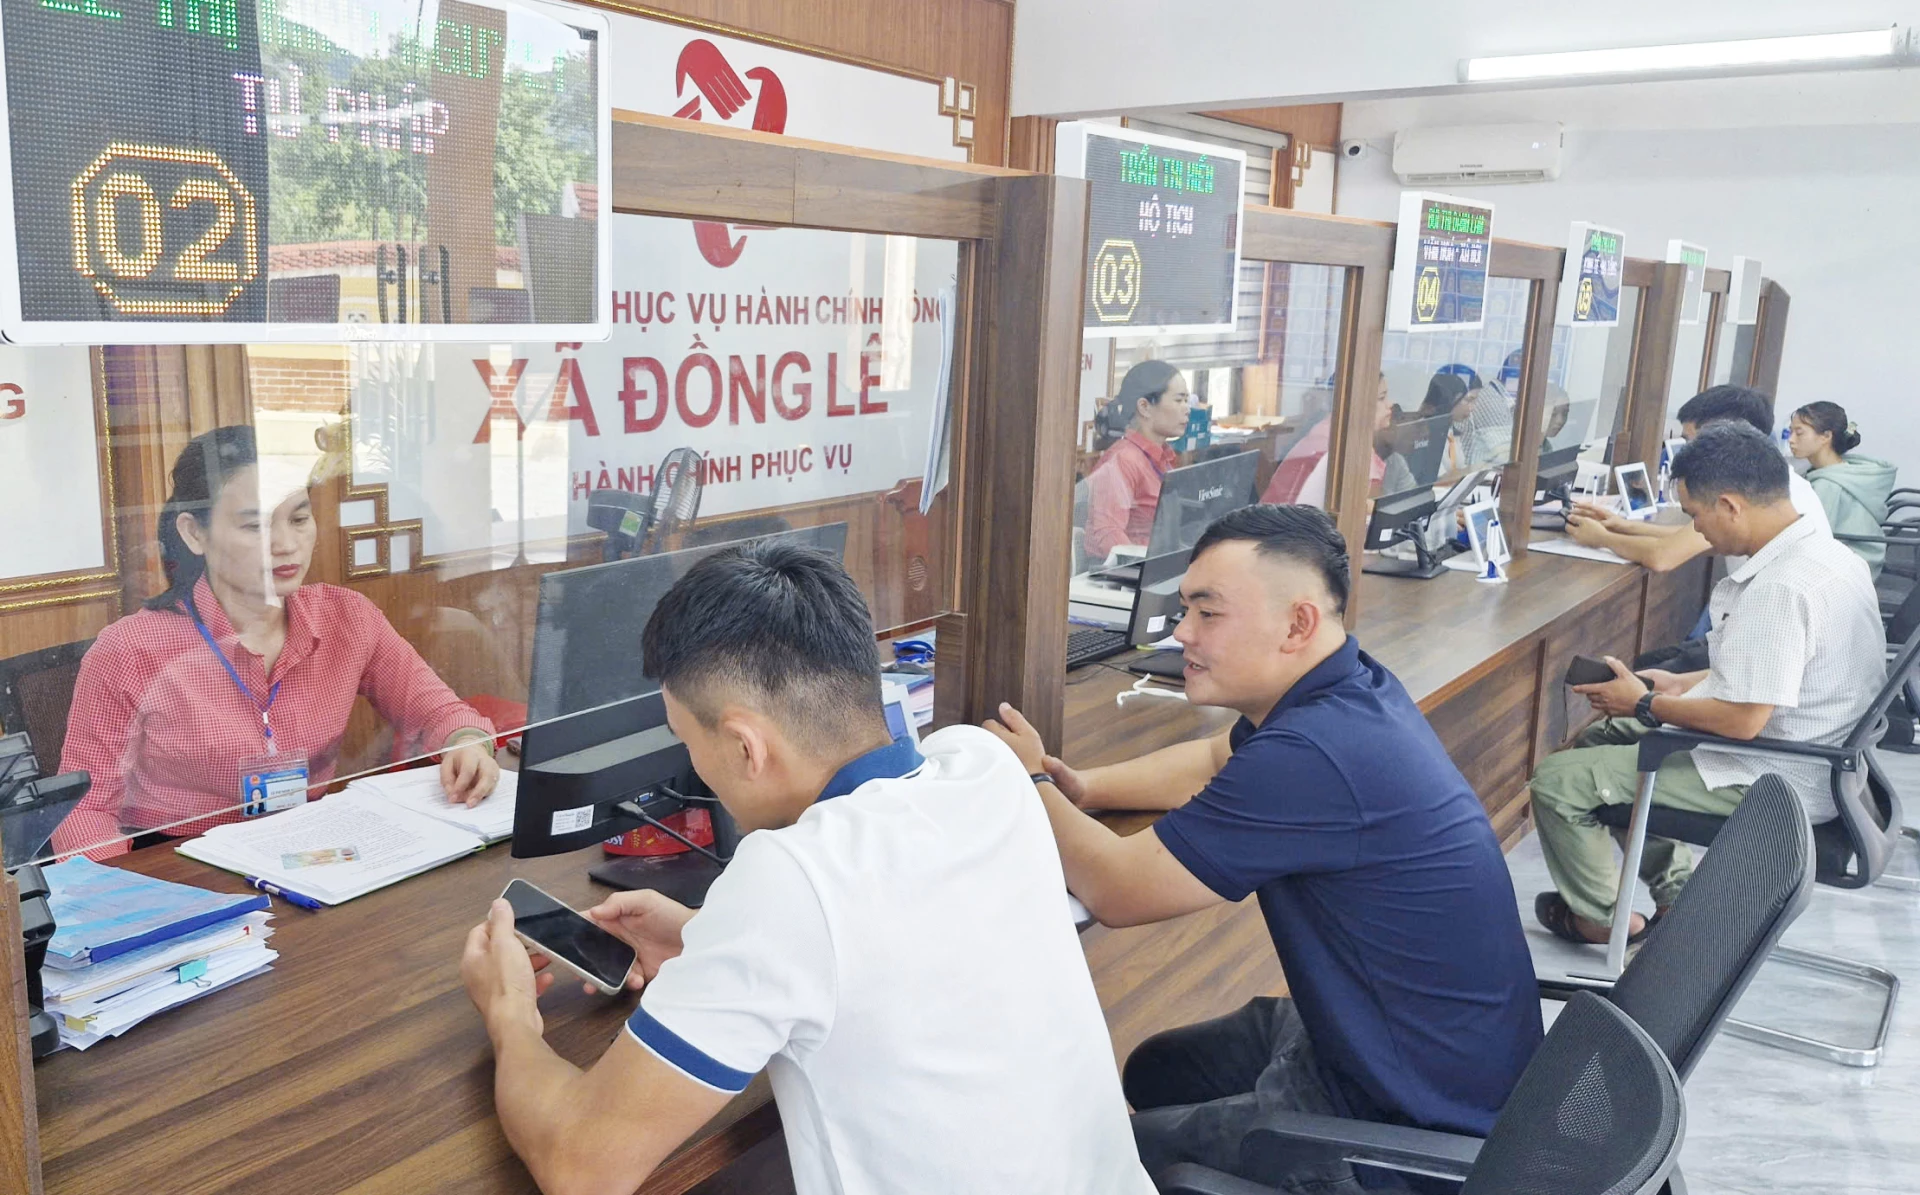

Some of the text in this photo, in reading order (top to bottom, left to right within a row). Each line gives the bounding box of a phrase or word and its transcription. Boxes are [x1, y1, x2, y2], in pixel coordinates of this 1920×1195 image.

[327, 81, 451, 155] PHÁP
[97, 172, 239, 281] 02
[1138, 193, 1161, 239] HỘ
[1099, 254, 1135, 305] 03
[1419, 277, 1437, 311] 04
[687, 293, 726, 333] VỤ
[736, 285, 809, 325] HÀNH
[815, 287, 883, 325] CHÍNH
[472, 332, 889, 444] XÃ ĐỒNG LÊ
[573, 460, 655, 501] HÀNH
[752, 447, 813, 483] PHỤC
[824, 443, 853, 475] VỤ
